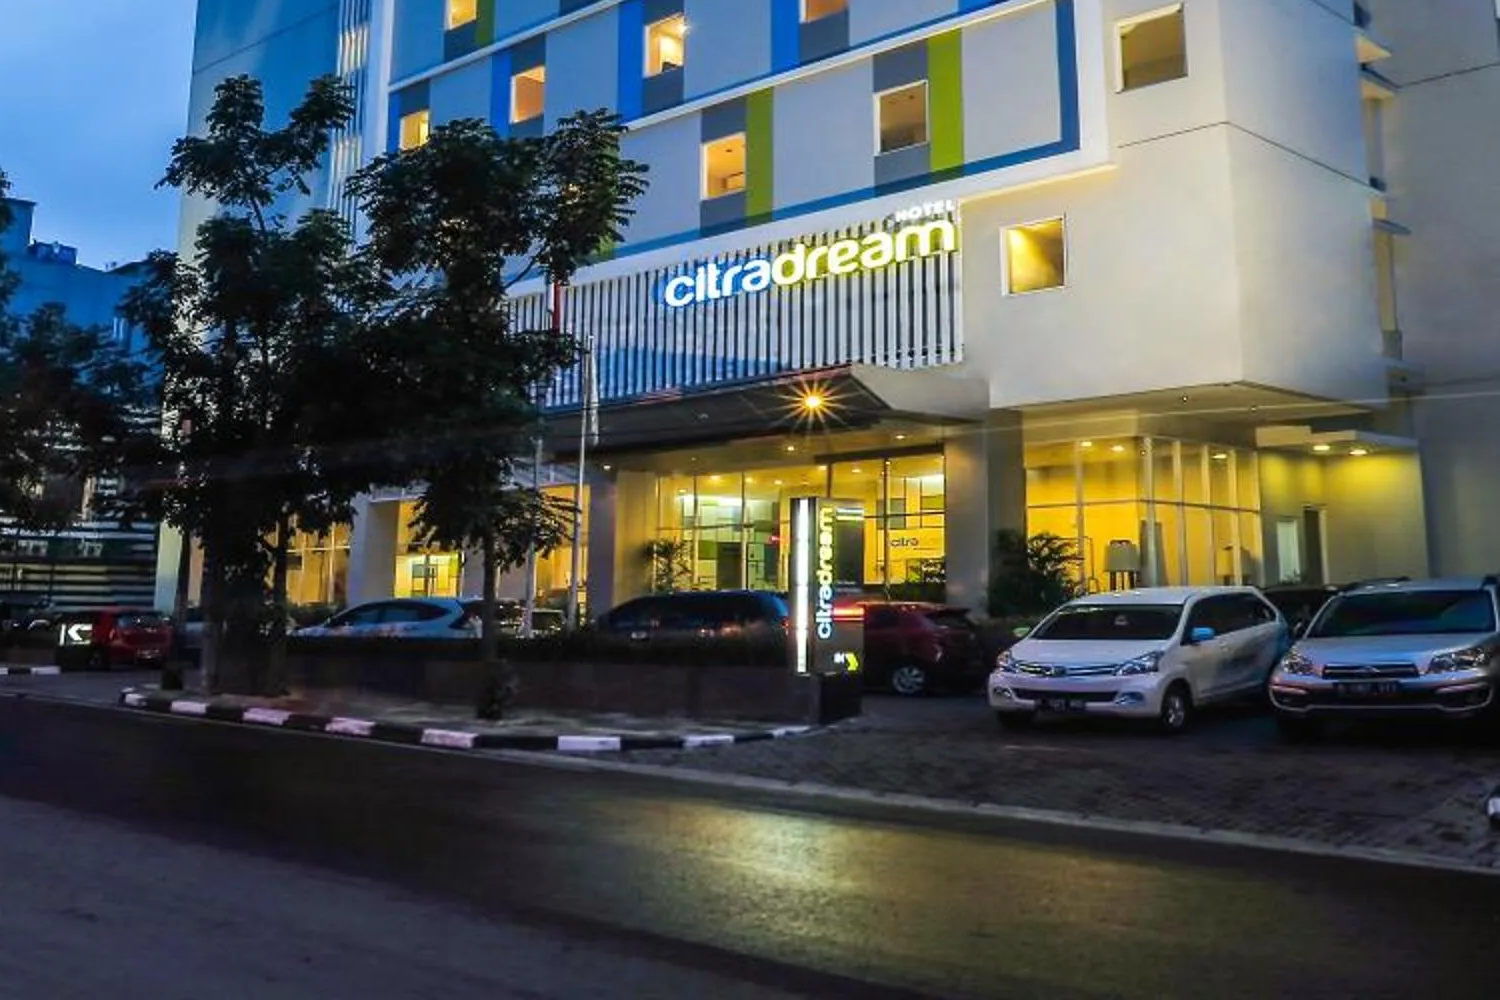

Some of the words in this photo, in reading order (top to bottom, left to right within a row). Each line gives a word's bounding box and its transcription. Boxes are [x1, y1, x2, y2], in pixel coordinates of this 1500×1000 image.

[895, 199, 955, 221] HOTEL
[665, 219, 956, 307] citradream
[815, 507, 833, 639] citradream
